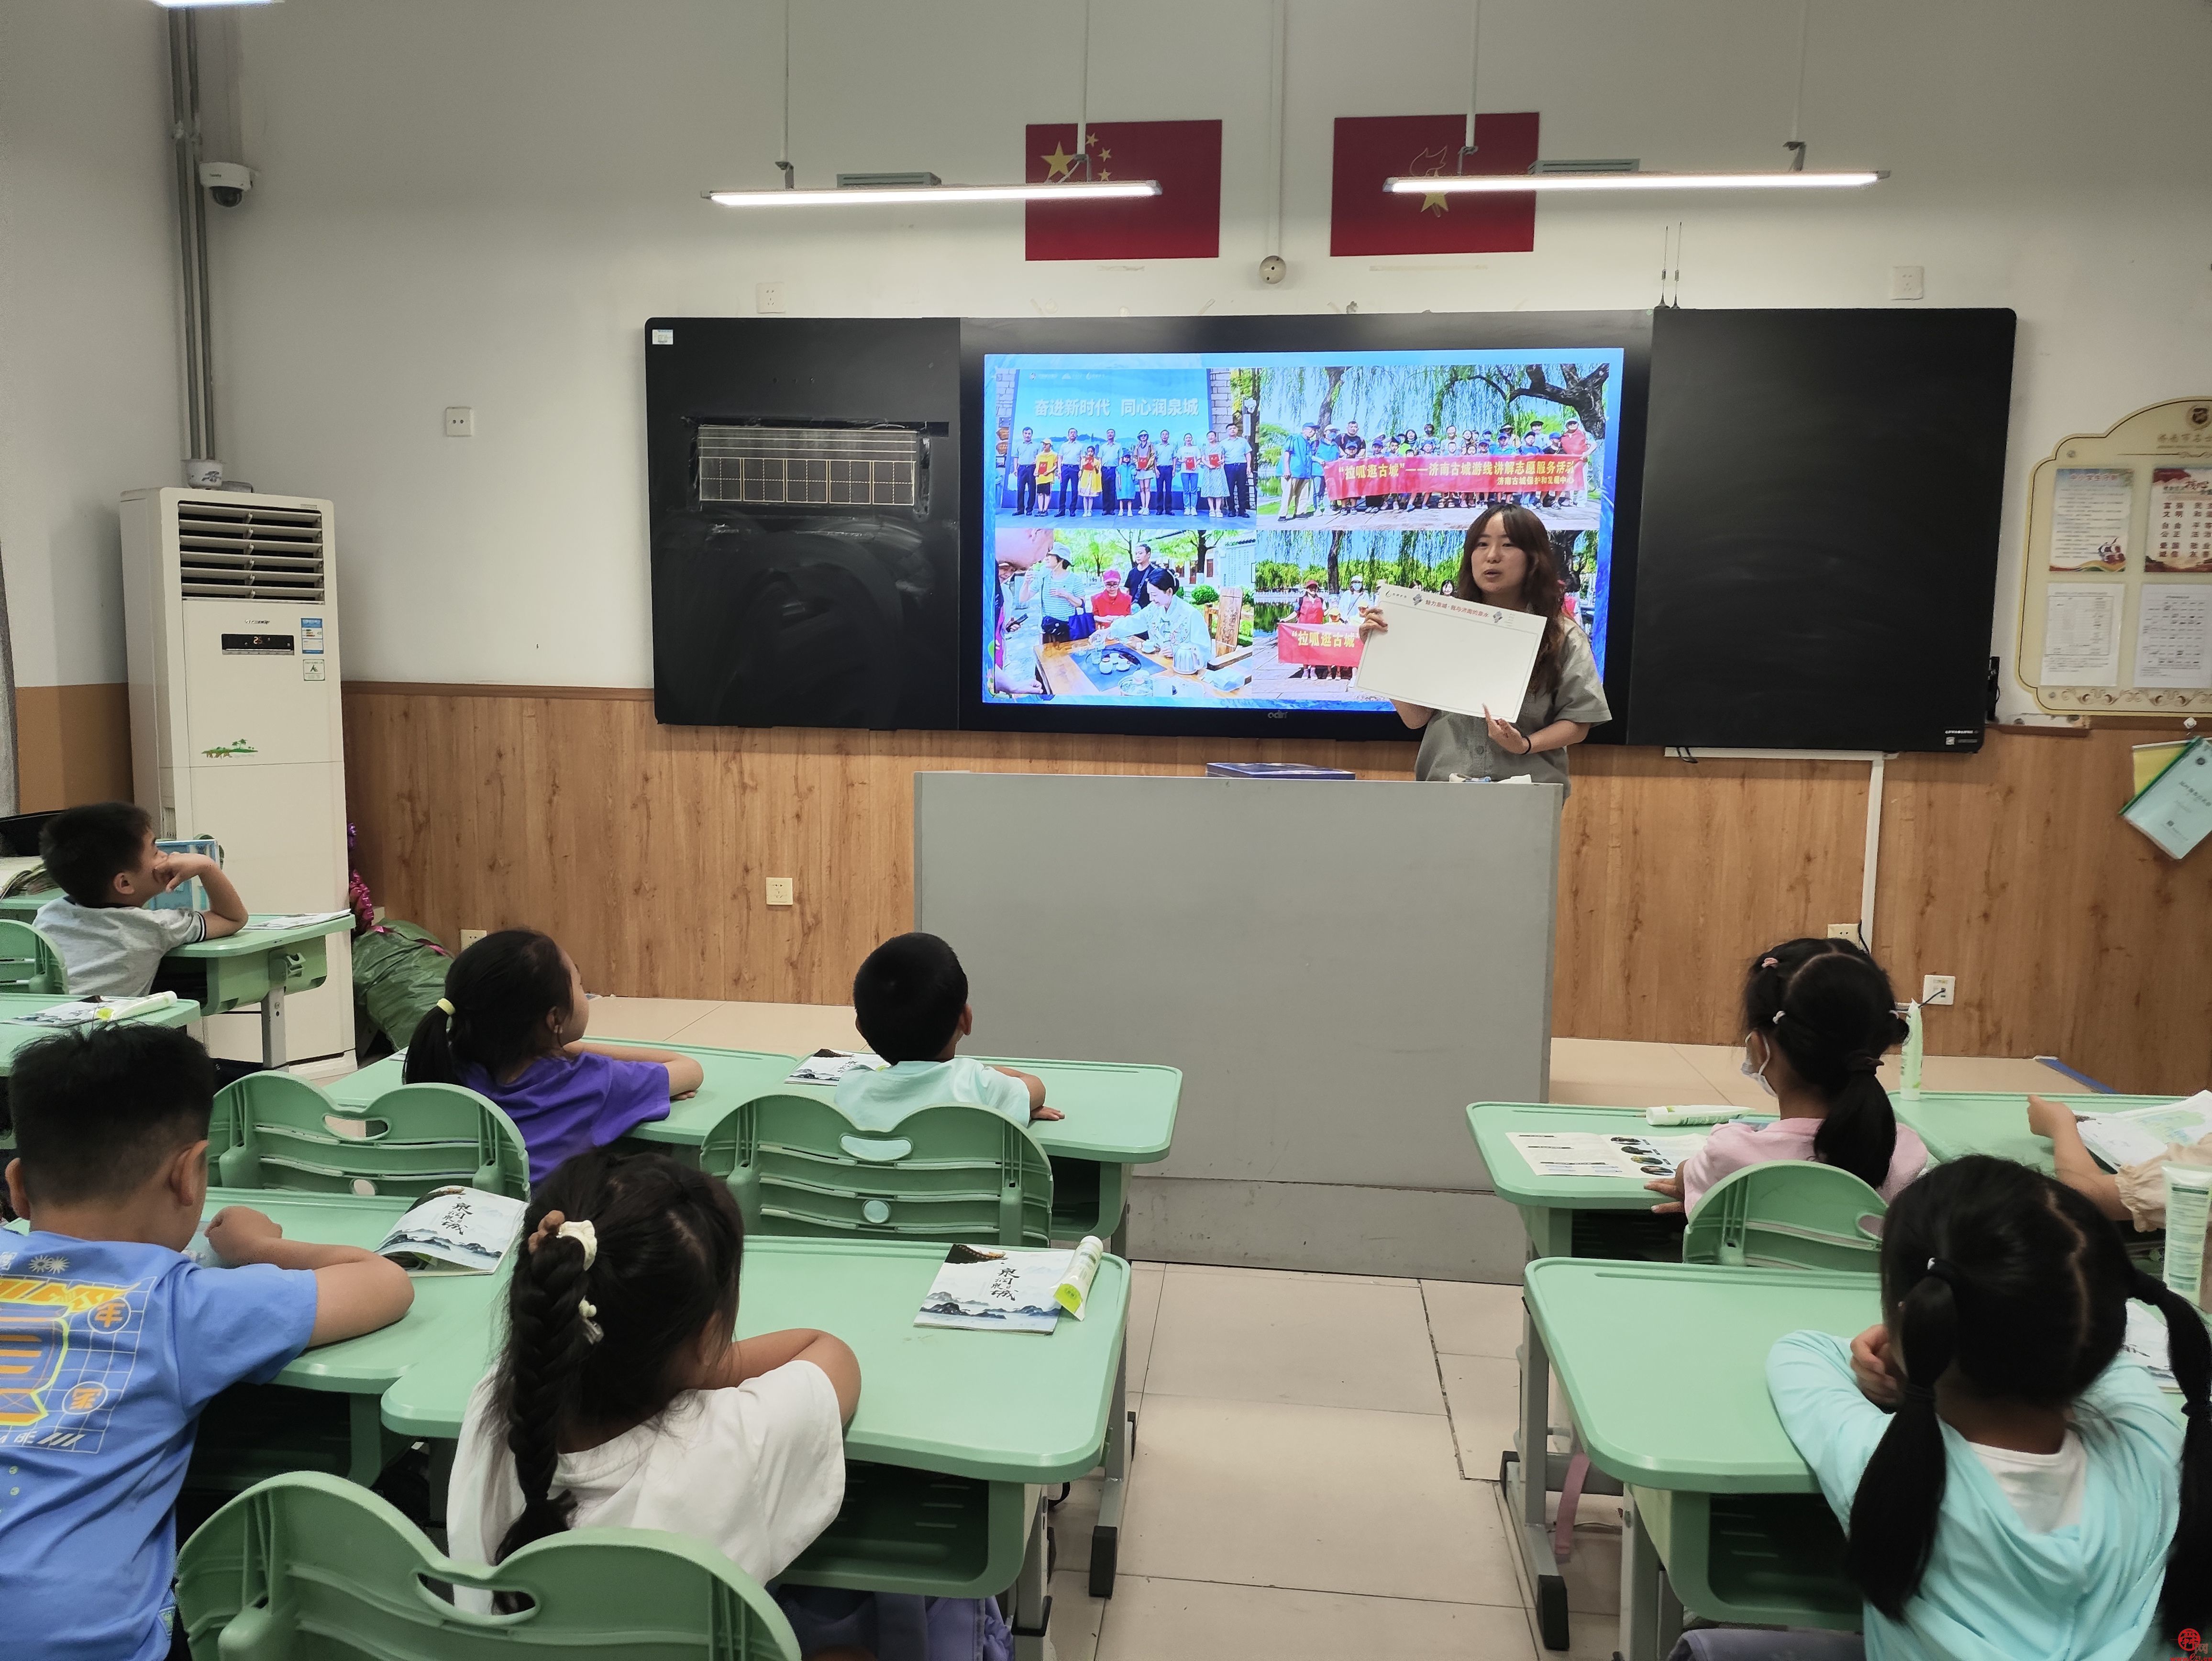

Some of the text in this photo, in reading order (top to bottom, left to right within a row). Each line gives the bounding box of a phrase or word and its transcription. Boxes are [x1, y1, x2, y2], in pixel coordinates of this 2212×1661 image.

[1034, 398, 1199, 417] 奋进新时代 同心润泉城
[95, 1302, 125, 1328] 年
